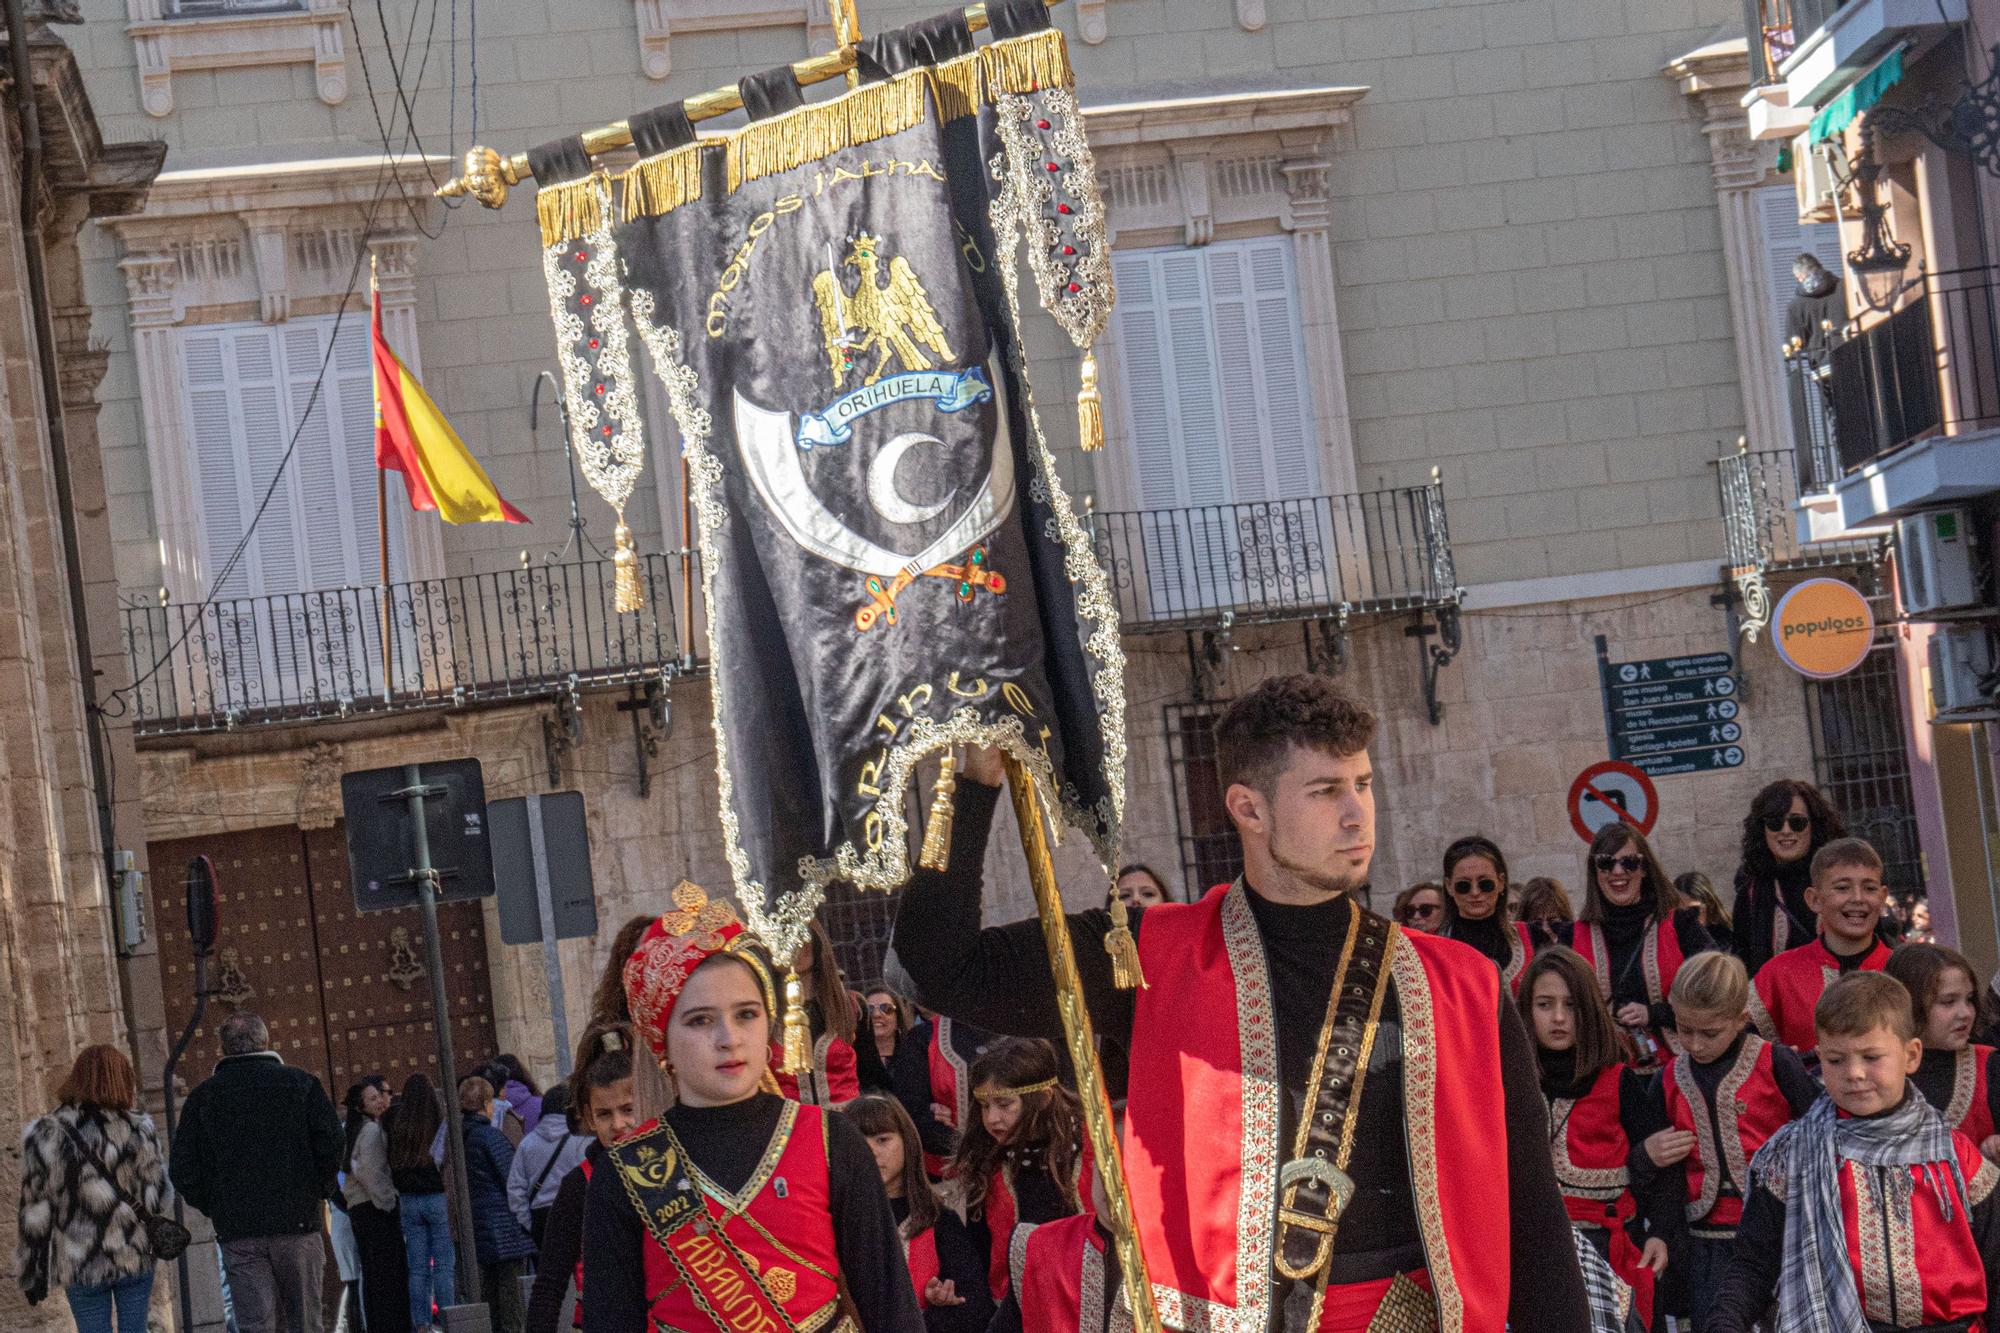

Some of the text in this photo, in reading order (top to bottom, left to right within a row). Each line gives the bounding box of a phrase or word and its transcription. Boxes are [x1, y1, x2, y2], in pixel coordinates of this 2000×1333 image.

[838, 377, 942, 417] ORIHUELA
[1692, 655, 1728, 665] convento
[1673, 669, 1684, 677] de
[1622, 684, 1668, 697] sala museo
[1623, 691, 1694, 706] San Juan de Dios
[1625, 709, 1653, 718] museo
[1626, 714, 1699, 729] de la Reconquista
[1628, 733, 1655, 744] iglesia
[1629, 743, 1666, 753] Santiago
[656, 1196, 691, 1224] 2022
